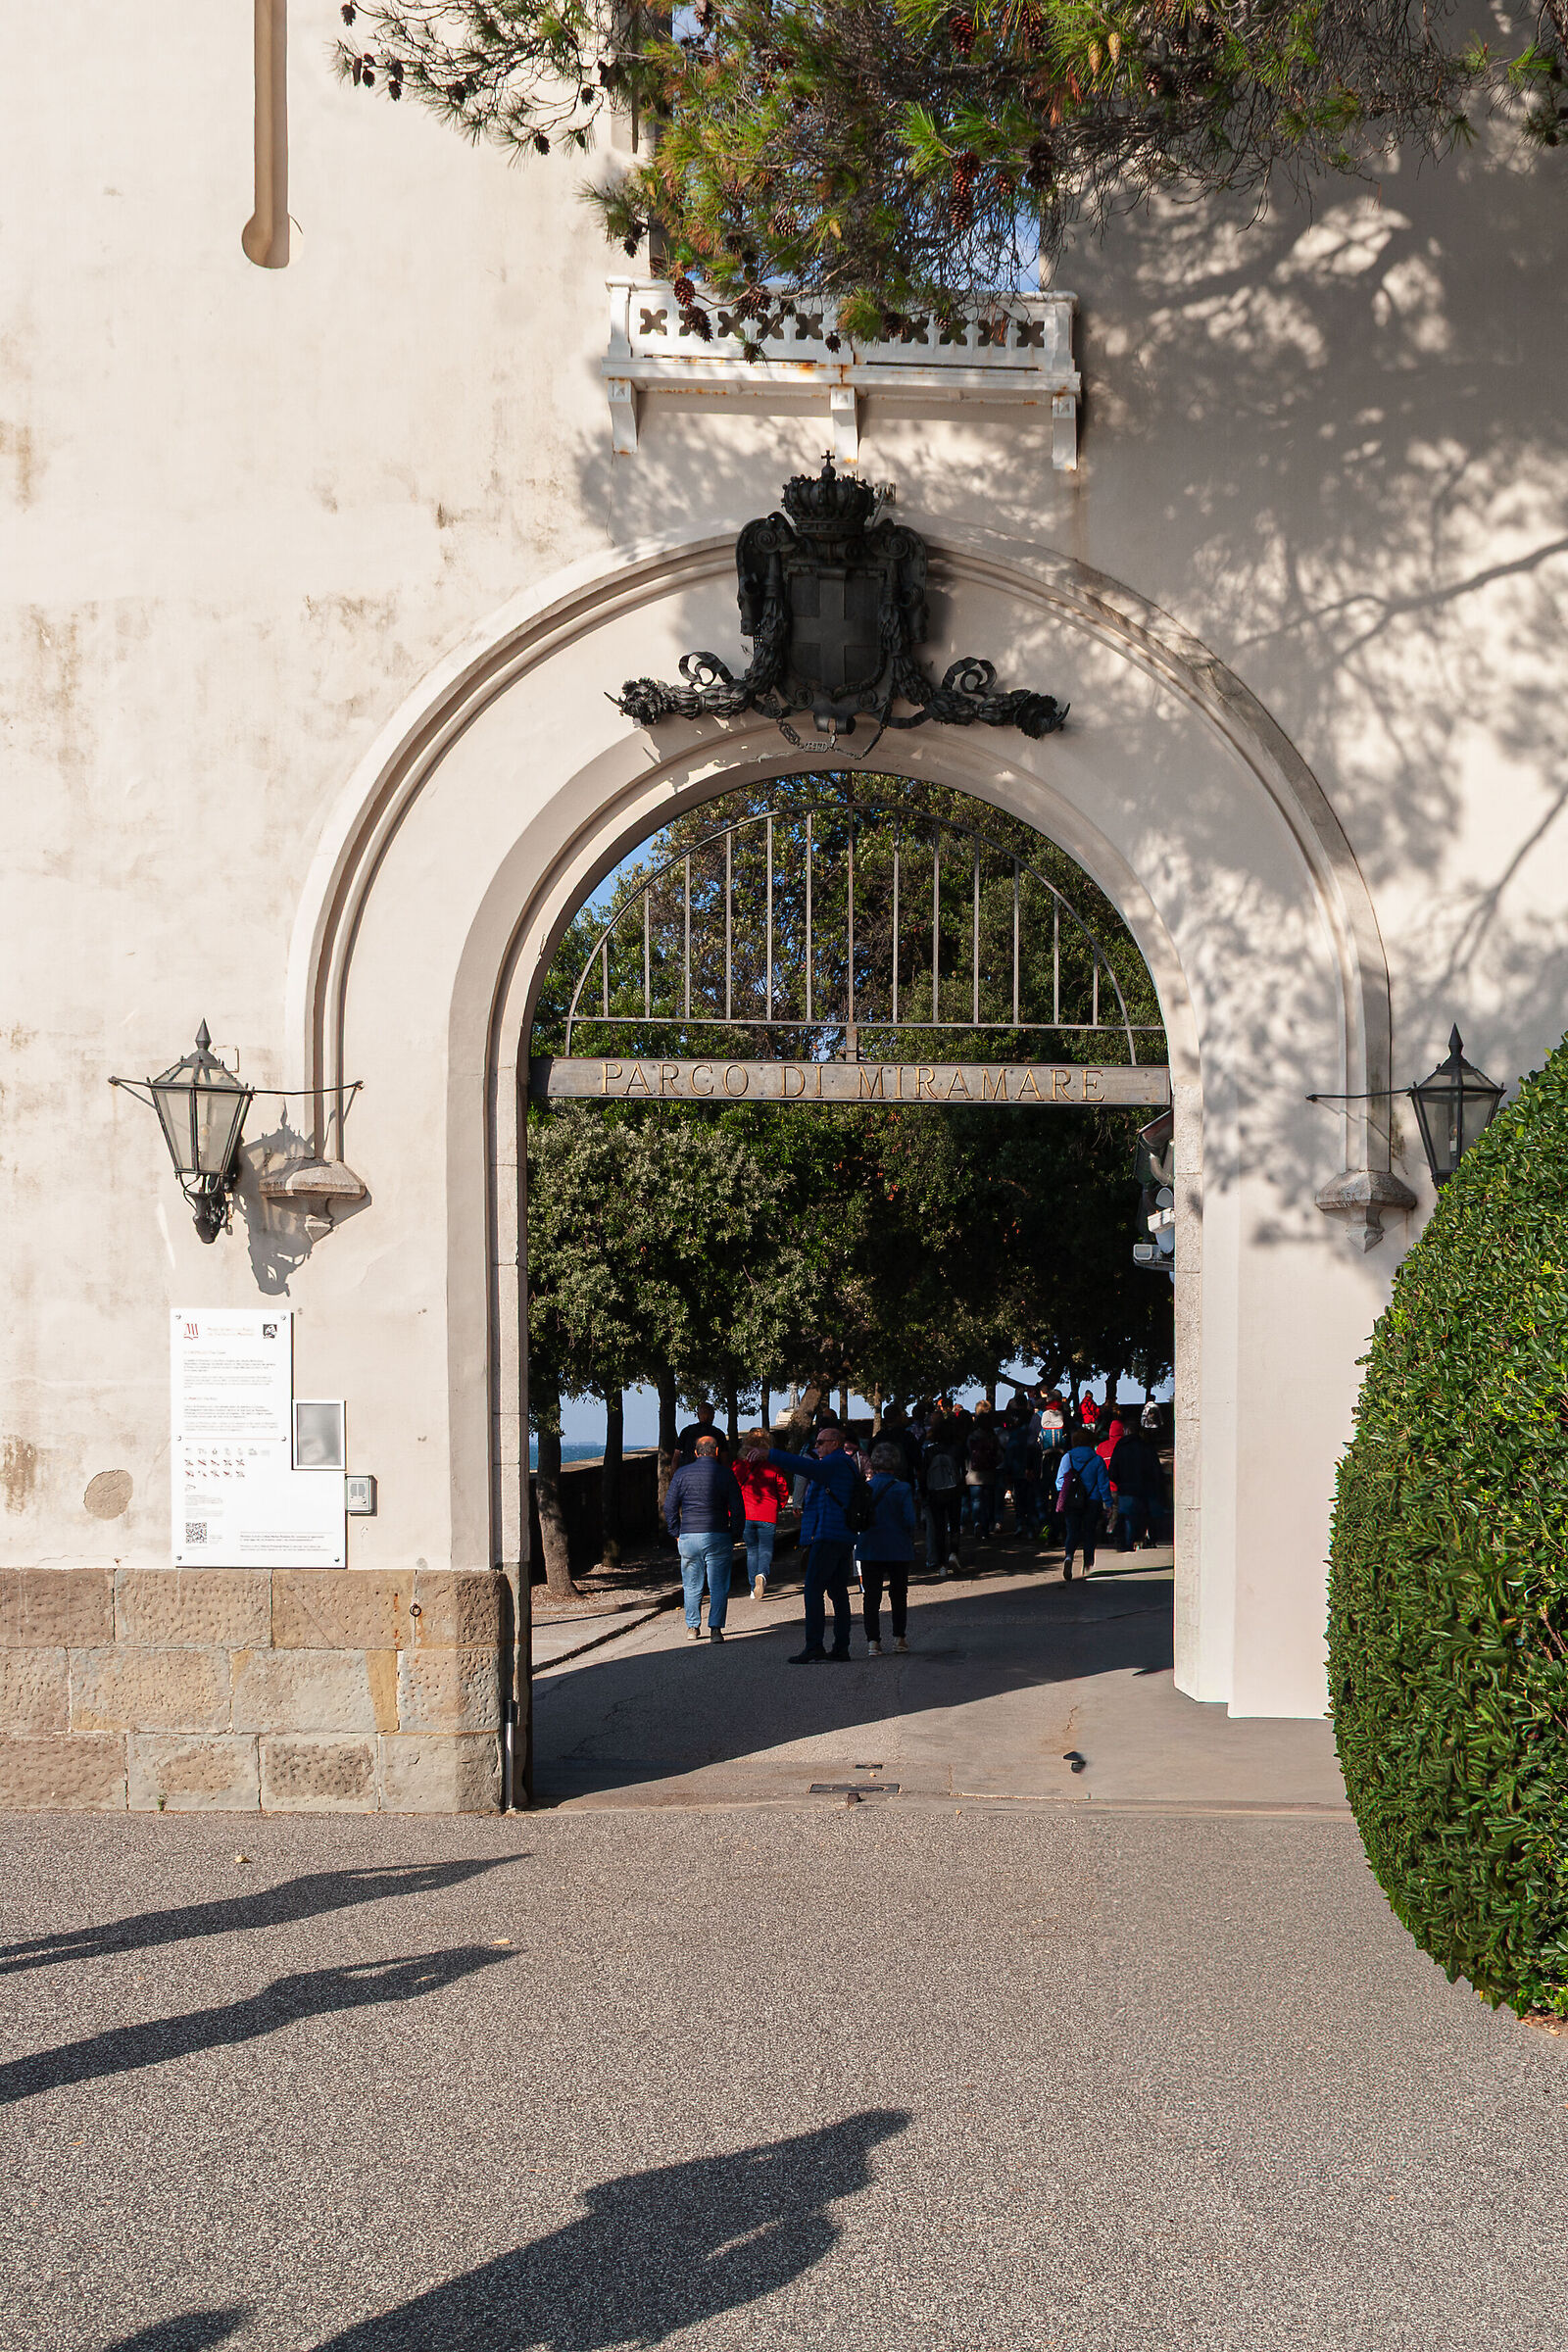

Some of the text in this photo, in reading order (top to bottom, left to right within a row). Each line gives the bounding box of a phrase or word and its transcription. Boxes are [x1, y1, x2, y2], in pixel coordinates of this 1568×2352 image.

[600, 1061, 1105, 1102] PARCO DI MIRAMARE
